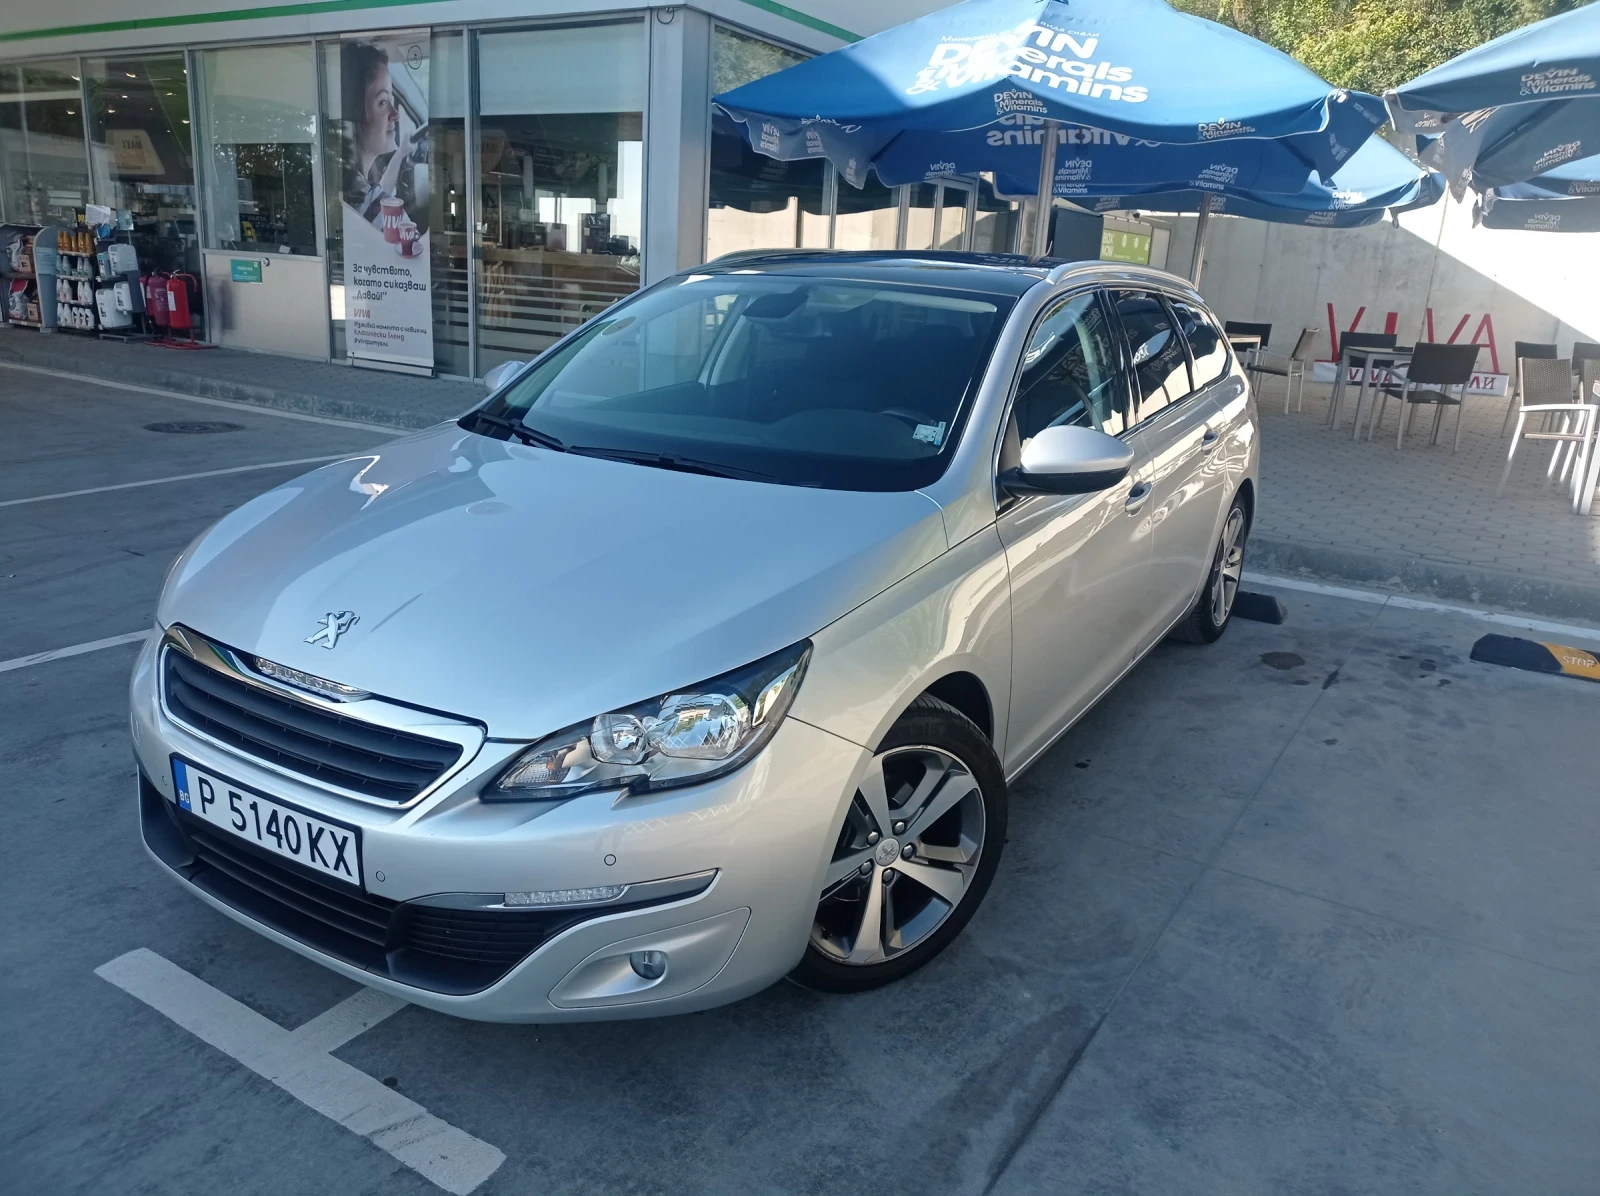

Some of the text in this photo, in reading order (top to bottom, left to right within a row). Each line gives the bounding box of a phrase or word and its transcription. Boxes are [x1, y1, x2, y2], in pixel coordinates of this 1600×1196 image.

[1521, 68, 1578, 81] DEVIN
[1526, 74, 1592, 87] Minerals
[993, 91, 1032, 102] DEVIN
[1000, 99, 1043, 107] Minerals
[1198, 121, 1241, 131] DEVIN
[353, 264, 412, 278] За чувството,
[353, 277, 382, 288] когато
[394, 280, 426, 292] казваш
[353, 308, 371, 319] VIVA
[1562, 655, 1595, 668] STOP
[179, 789, 191, 804] BG
[198, 776, 215, 815] P
[228, 790, 302, 855] 5140
